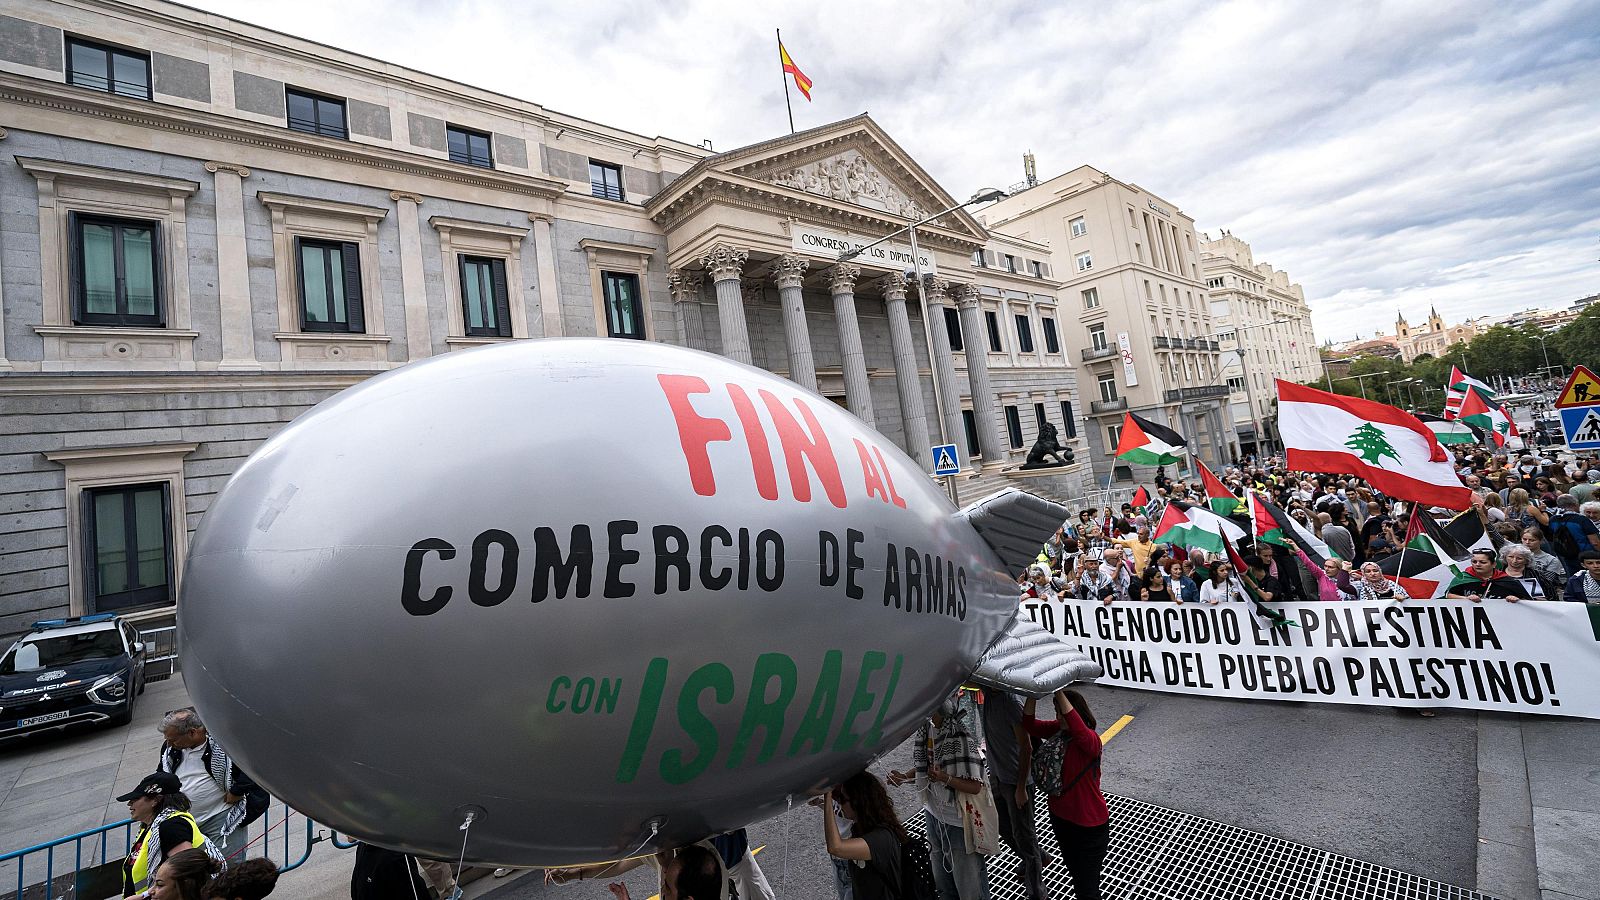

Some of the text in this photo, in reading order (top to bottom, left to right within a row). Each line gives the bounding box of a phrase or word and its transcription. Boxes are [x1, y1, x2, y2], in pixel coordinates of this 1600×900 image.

[801, 233, 850, 252] CONGRESO
[870, 247, 885, 259] LOS
[890, 250, 929, 267] DIPUTAOS
[657, 374, 907, 510] FIN AL
[400, 519, 967, 622] COMERCIO DE ARMAS
[1064, 604, 1091, 638] AL
[1095, 606, 1241, 645] GENOCIDIO
[1248, 608, 1292, 646] EN
[1298, 606, 1503, 650] PALESTINA
[1078, 644, 1561, 707] UCHA DEL PUEBLO PALESTINO!
[545, 649, 905, 786] CON ISRAEL
